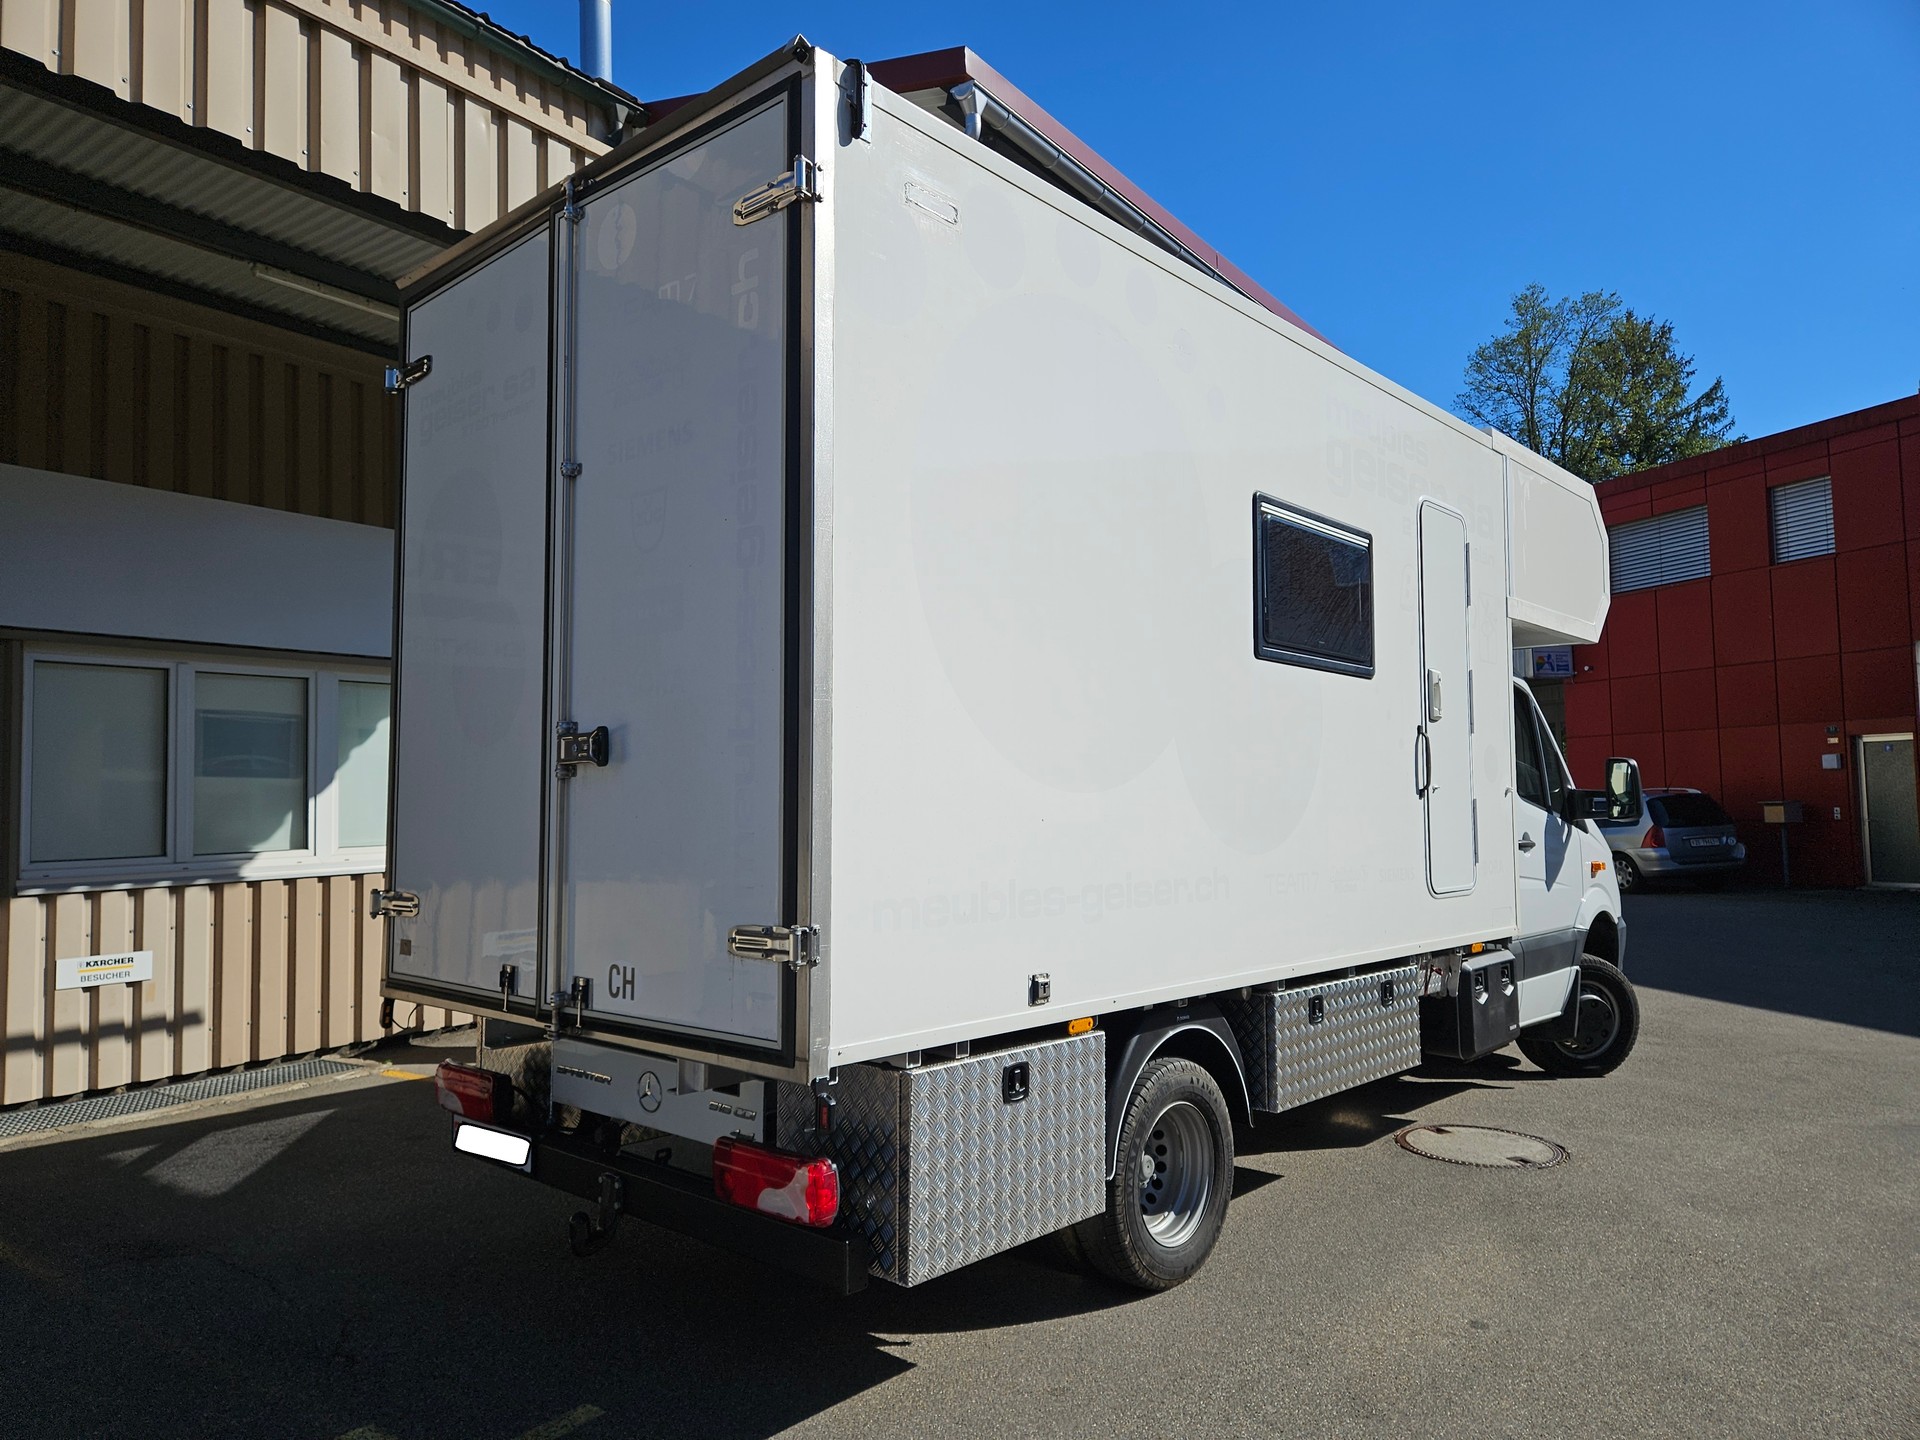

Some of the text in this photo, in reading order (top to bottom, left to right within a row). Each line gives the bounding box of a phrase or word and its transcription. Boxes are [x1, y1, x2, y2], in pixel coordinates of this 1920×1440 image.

[872, 866, 1231, 933] meubles-geiser.ch
[85, 957, 134, 968] KÄRCHER
[80, 970, 131, 982] BESUCHER
[608, 963, 635, 1000] CH
